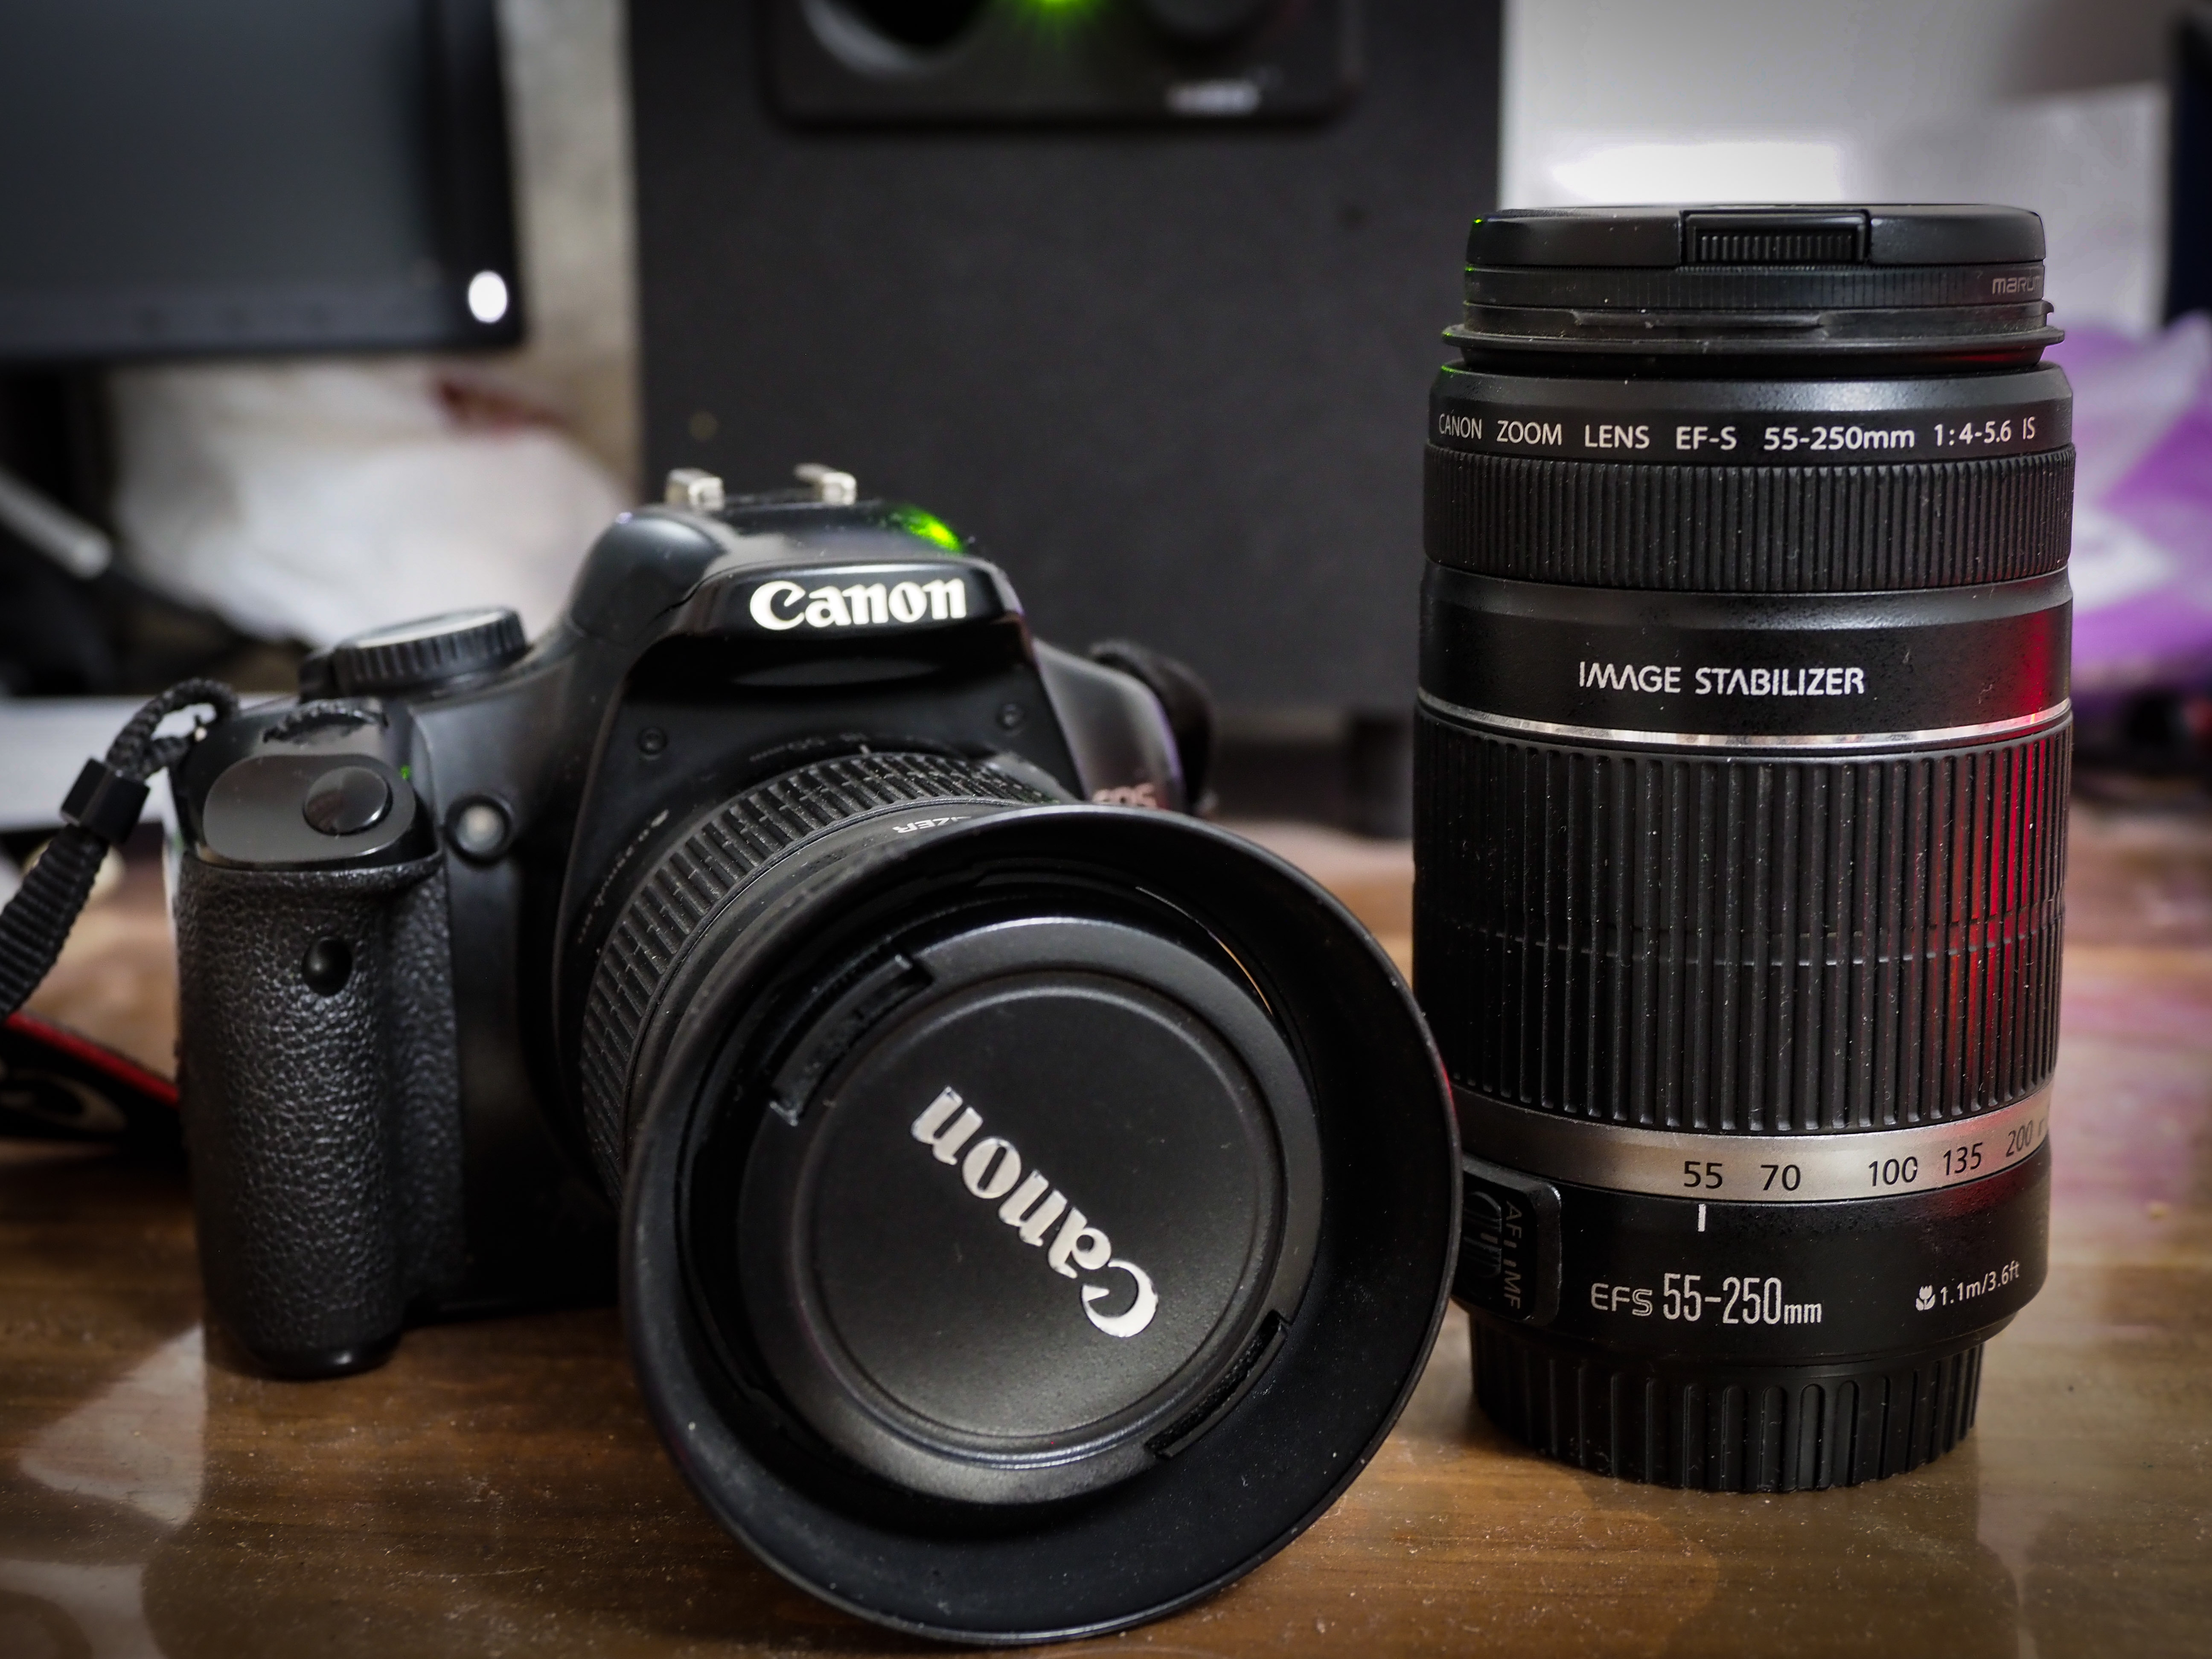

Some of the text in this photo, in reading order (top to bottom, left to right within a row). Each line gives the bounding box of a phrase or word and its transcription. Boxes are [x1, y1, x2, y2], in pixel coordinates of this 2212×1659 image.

[1438, 413, 2036, 451] CANON ZOOM LENS EF-S 55-250mm 1:4-5.6 IS
[750, 578, 967, 630] Canon
[1578, 661, 1865, 696] IMAGE STABILIZER
[1683, 1161, 1723, 1190] 55
[1760, 1164, 1801, 1191] 70
[1868, 1156, 1918, 1187] 100
[1943, 1141, 1984, 1176] 135
[2005, 1120, 2034, 1158] 200
[911, 1086, 1159, 1338] Canon
[1503, 1200, 1522, 1310] AF MF
[1590, 1272, 1822, 1325] EFS 55-250mm
[1940, 1260, 2020, 1306] 1.1m/3.6ft
